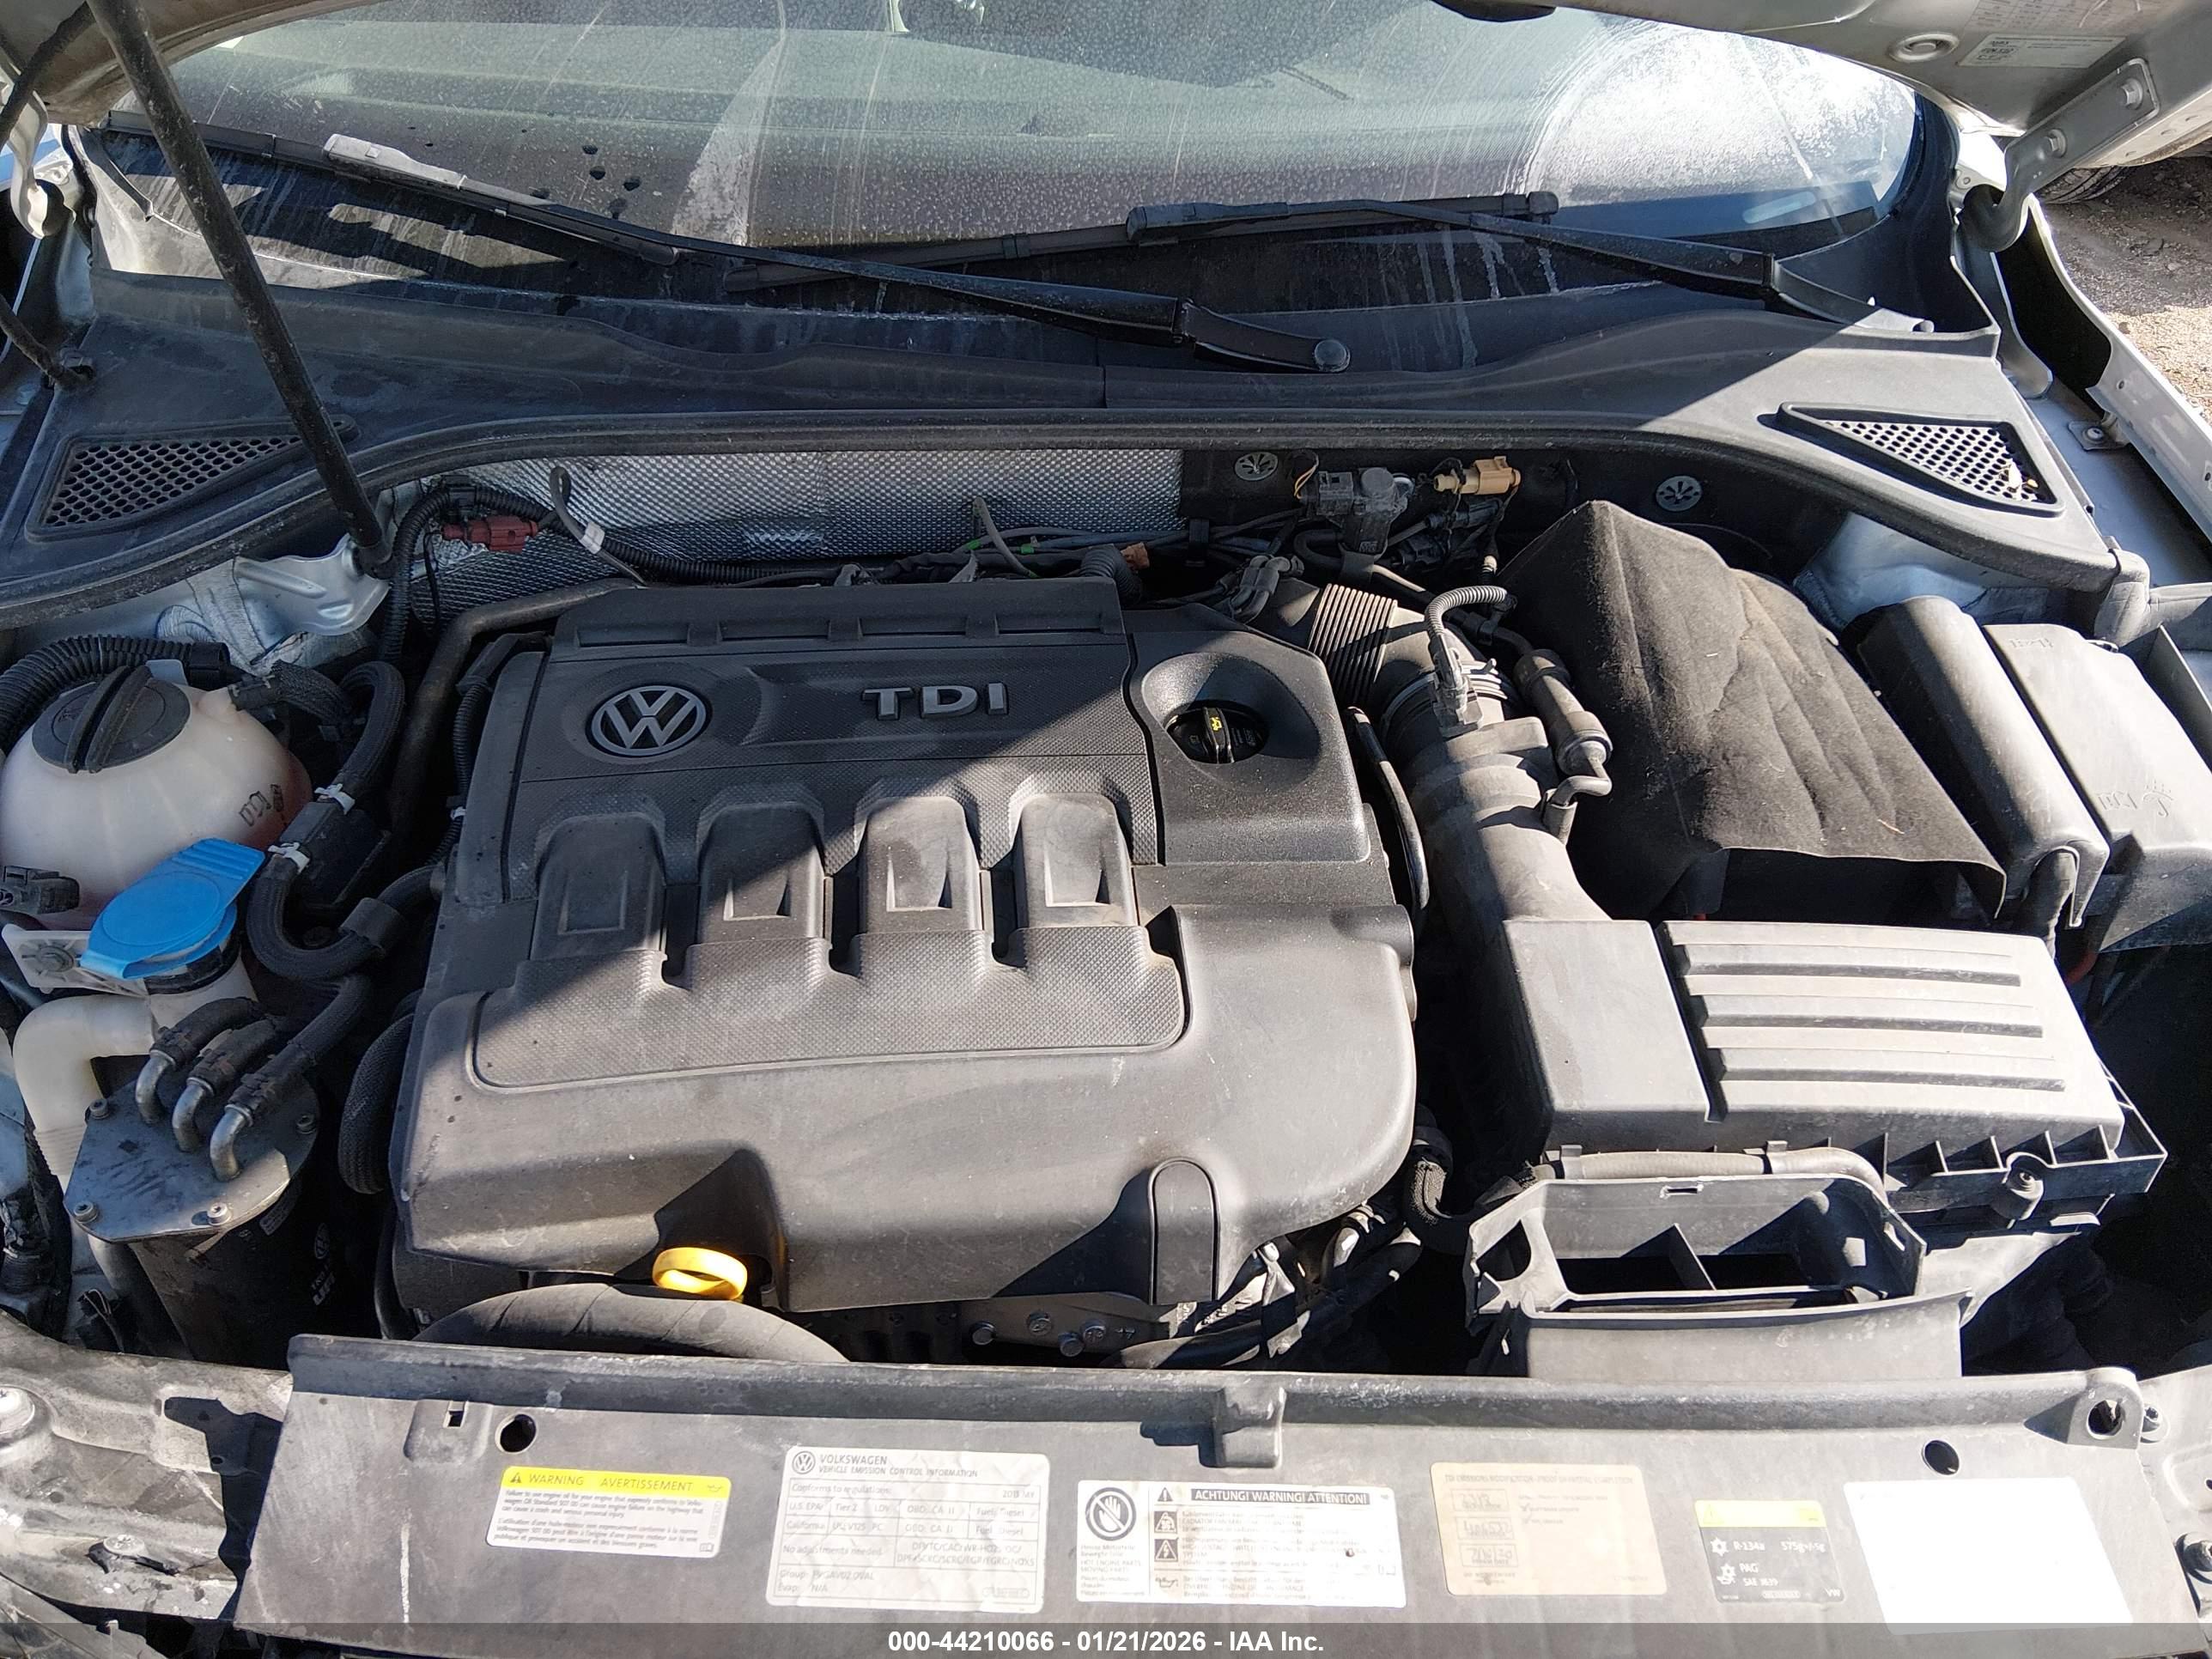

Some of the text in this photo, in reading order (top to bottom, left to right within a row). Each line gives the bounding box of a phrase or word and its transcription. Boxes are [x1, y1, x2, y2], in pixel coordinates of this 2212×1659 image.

[862, 683, 1010, 721] TDI
[820, 1454, 888, 1465] VOLKSWAGEN
[819, 1465, 978, 1478] VEHICLE EMISSION CONTROL INFORMATION
[529, 1474, 694, 1492] WARNING AVERTISSEMENT
[834, 1485, 842, 1493] to
[1195, 1489, 1368, 1505] ACHTUNG! WARNING! ATTENTION!
[1739, 1563, 1759, 1573] PAG
